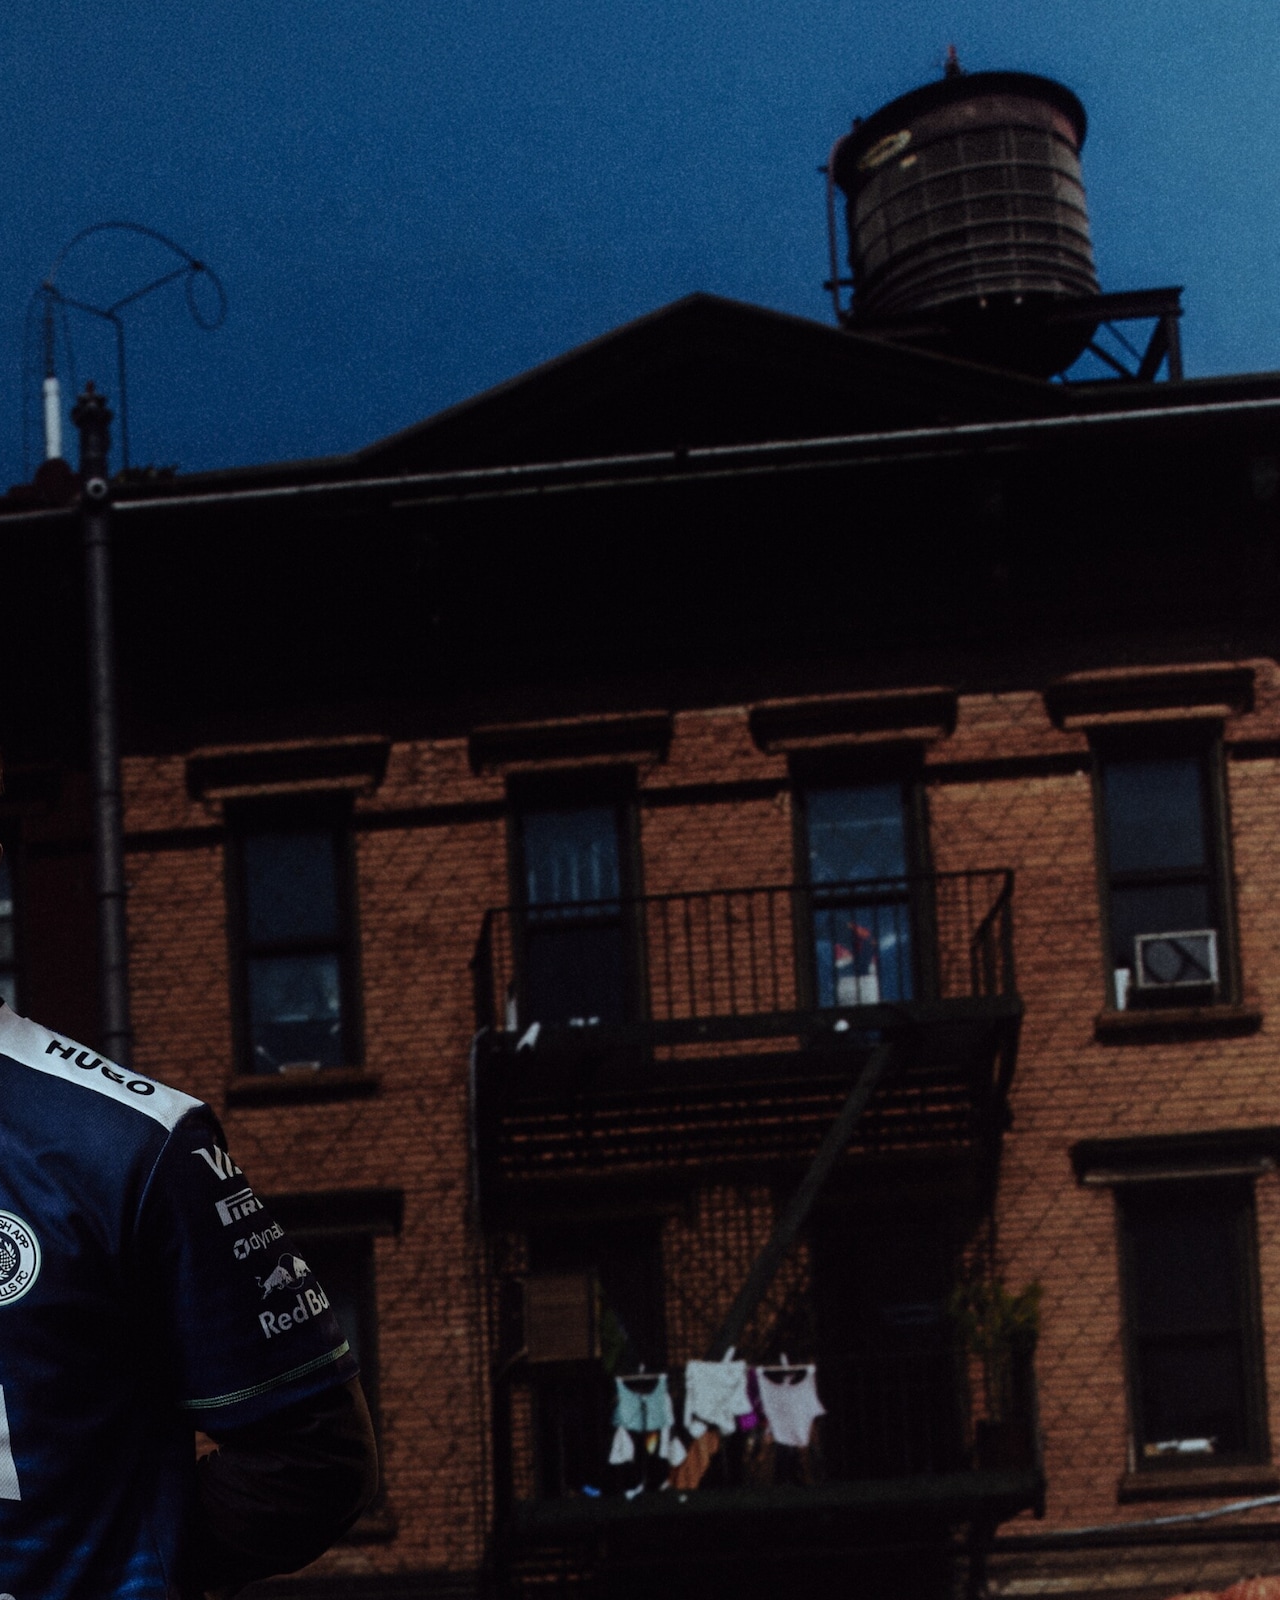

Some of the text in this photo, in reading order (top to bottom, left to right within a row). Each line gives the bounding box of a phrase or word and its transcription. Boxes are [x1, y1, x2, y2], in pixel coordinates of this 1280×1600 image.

[45, 1040, 155, 1096] HUGO
[10, 1228, 30, 1250] APP
[15, 1269, 29, 1286] FC
[258, 1293, 310, 1340] Red
